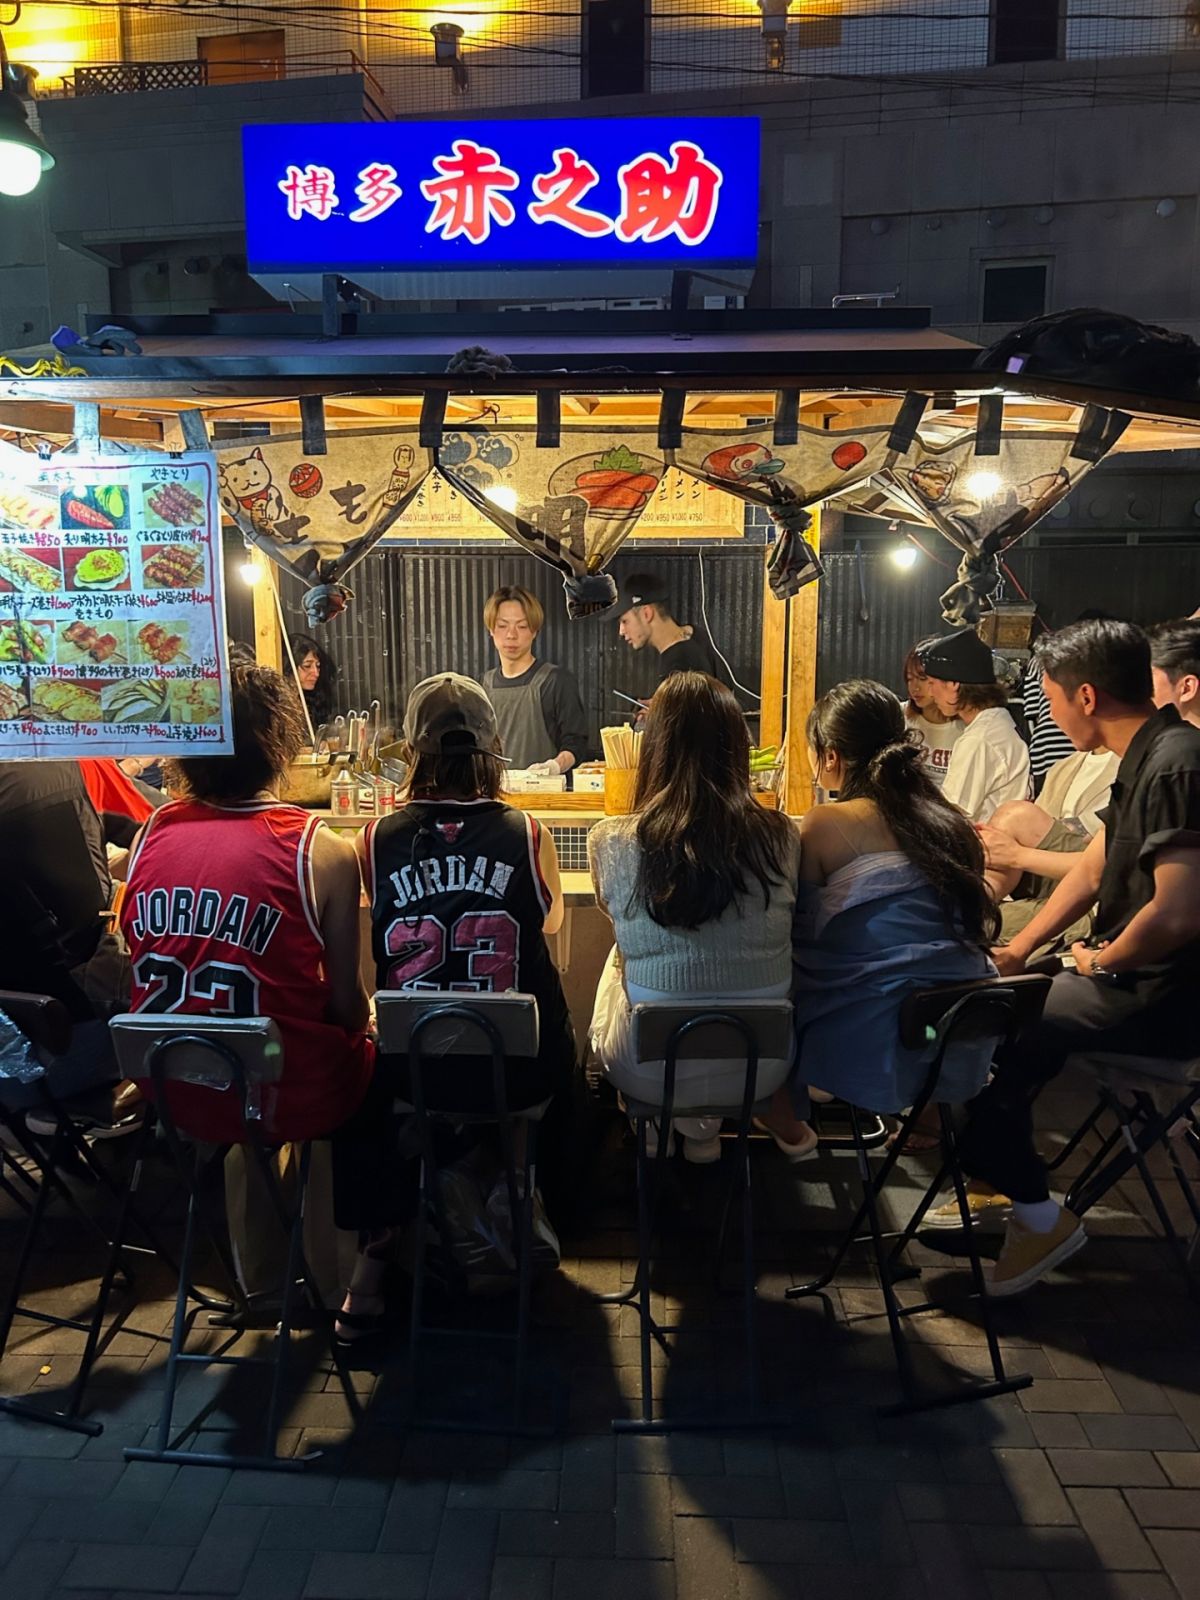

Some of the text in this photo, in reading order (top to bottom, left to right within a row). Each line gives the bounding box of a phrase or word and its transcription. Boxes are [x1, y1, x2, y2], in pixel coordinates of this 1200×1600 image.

[278, 139, 723, 246] 博多 赤之助
[150, 467, 190, 481] やきとり
[389, 855, 515, 908] JORDAN
[132, 887, 283, 956] JORDAN
[385, 910, 520, 991] 23
[133, 952, 260, 1018] 23
